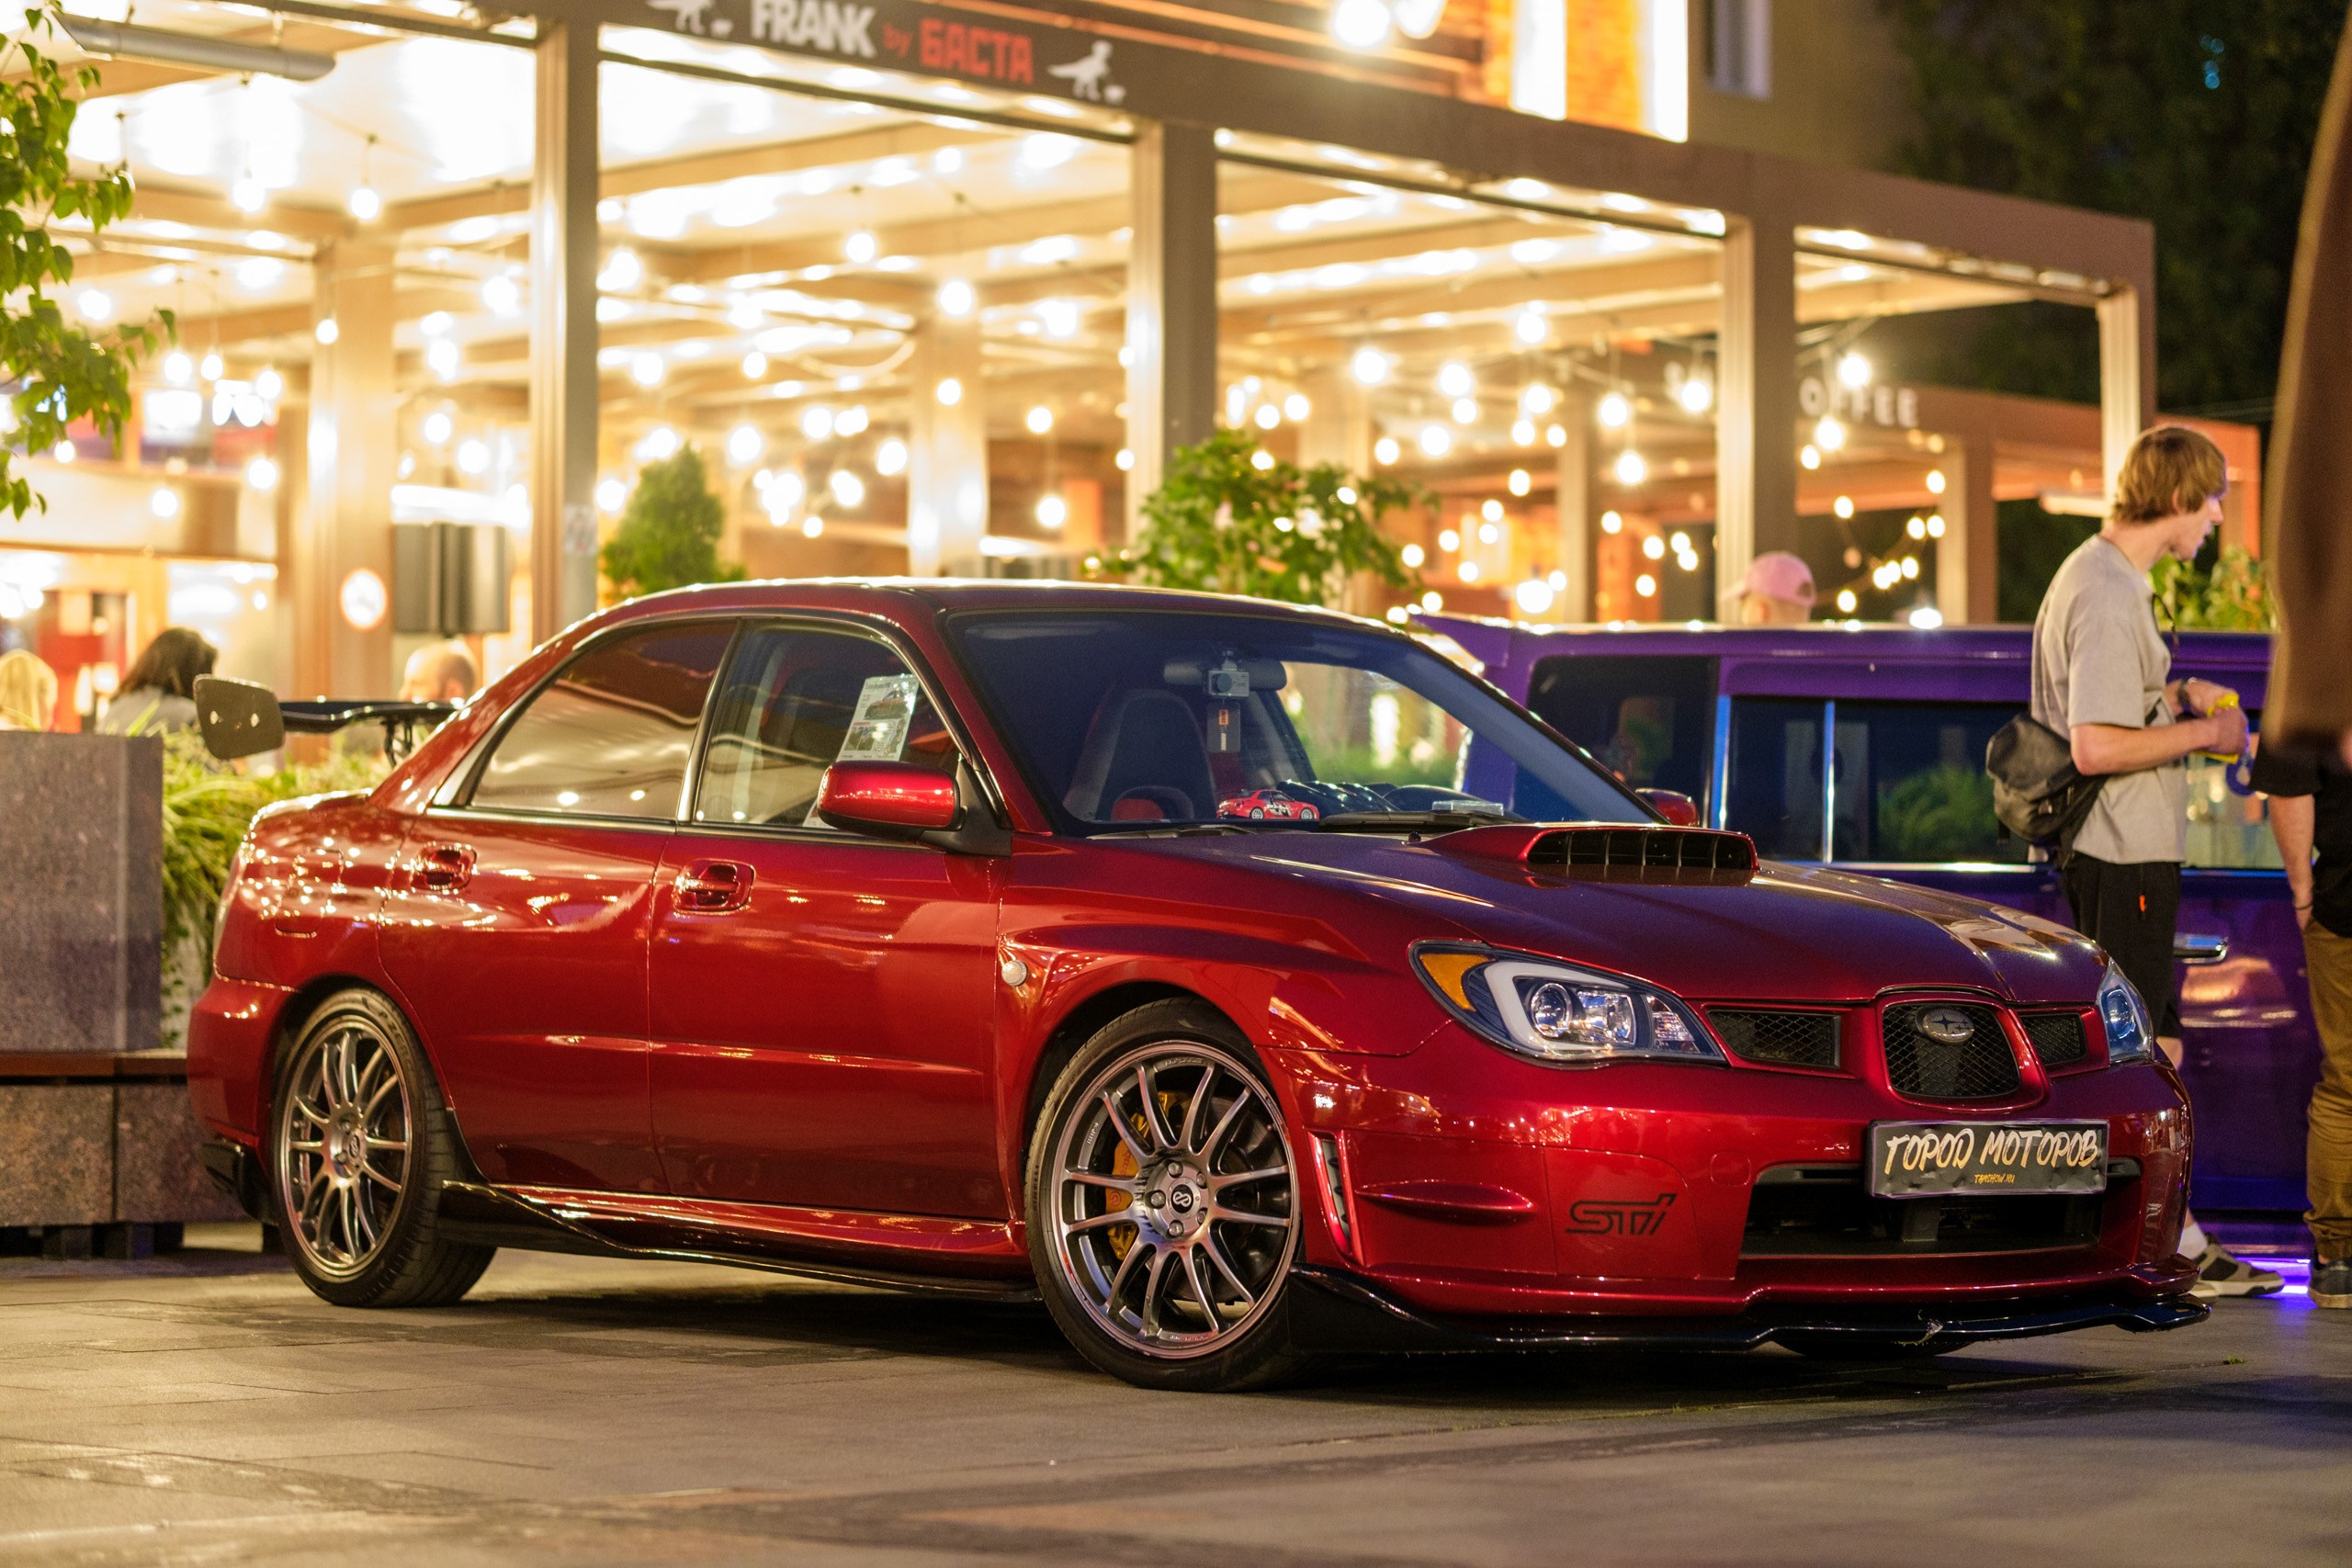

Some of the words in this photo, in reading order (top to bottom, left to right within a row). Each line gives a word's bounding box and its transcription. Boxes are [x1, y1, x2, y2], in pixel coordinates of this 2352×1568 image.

[751, 0, 877, 58] FRANK
[882, 22, 912, 58] by
[921, 17, 1035, 84] БАСТА
[1980, 1129, 2099, 1168] МОТОРОВ
